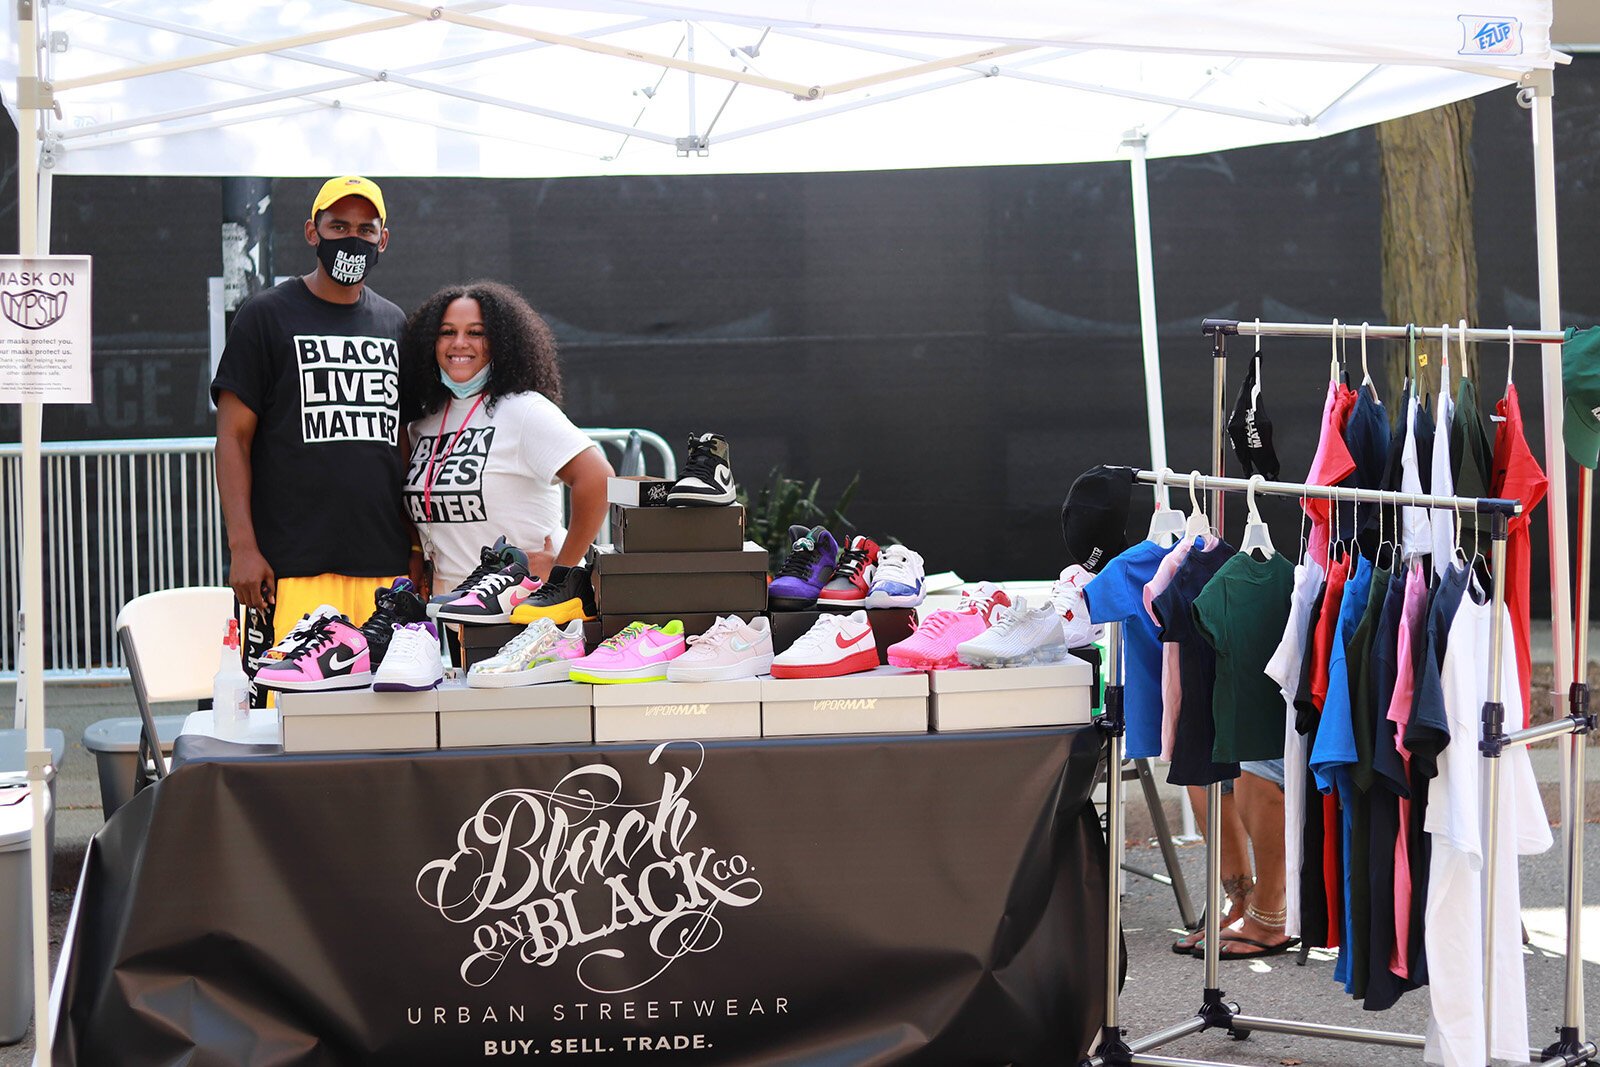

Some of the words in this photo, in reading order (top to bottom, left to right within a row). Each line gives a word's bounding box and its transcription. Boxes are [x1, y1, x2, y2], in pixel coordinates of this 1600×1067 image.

[335, 260, 365, 273] LIVES
[336, 249, 367, 265] BLACK
[49, 272, 75, 286] ON
[11, 347, 33, 355] masks
[32, 338, 56, 346] protect
[298, 339, 398, 368] BLACK
[304, 371, 399, 405] LIVES
[304, 410, 397, 442] MATTER
[412, 428, 494, 461] BLACK
[403, 495, 486, 522] ATTER
[645, 703, 711, 716] VAPORMAX
[813, 698, 878, 711] VAPORMAX
[418, 750, 704, 922] Black
[473, 915, 528, 955] ON
[516, 848, 745, 967] BLACK
[713, 854, 756, 881] CO.
[407, 1005, 526, 1025] URBAN
[553, 997, 790, 1022] STREETWEAR
[484, 1040, 540, 1056] BUY.
[551, 1037, 614, 1054] SELL.
[623, 1034, 714, 1052] TRADE.
